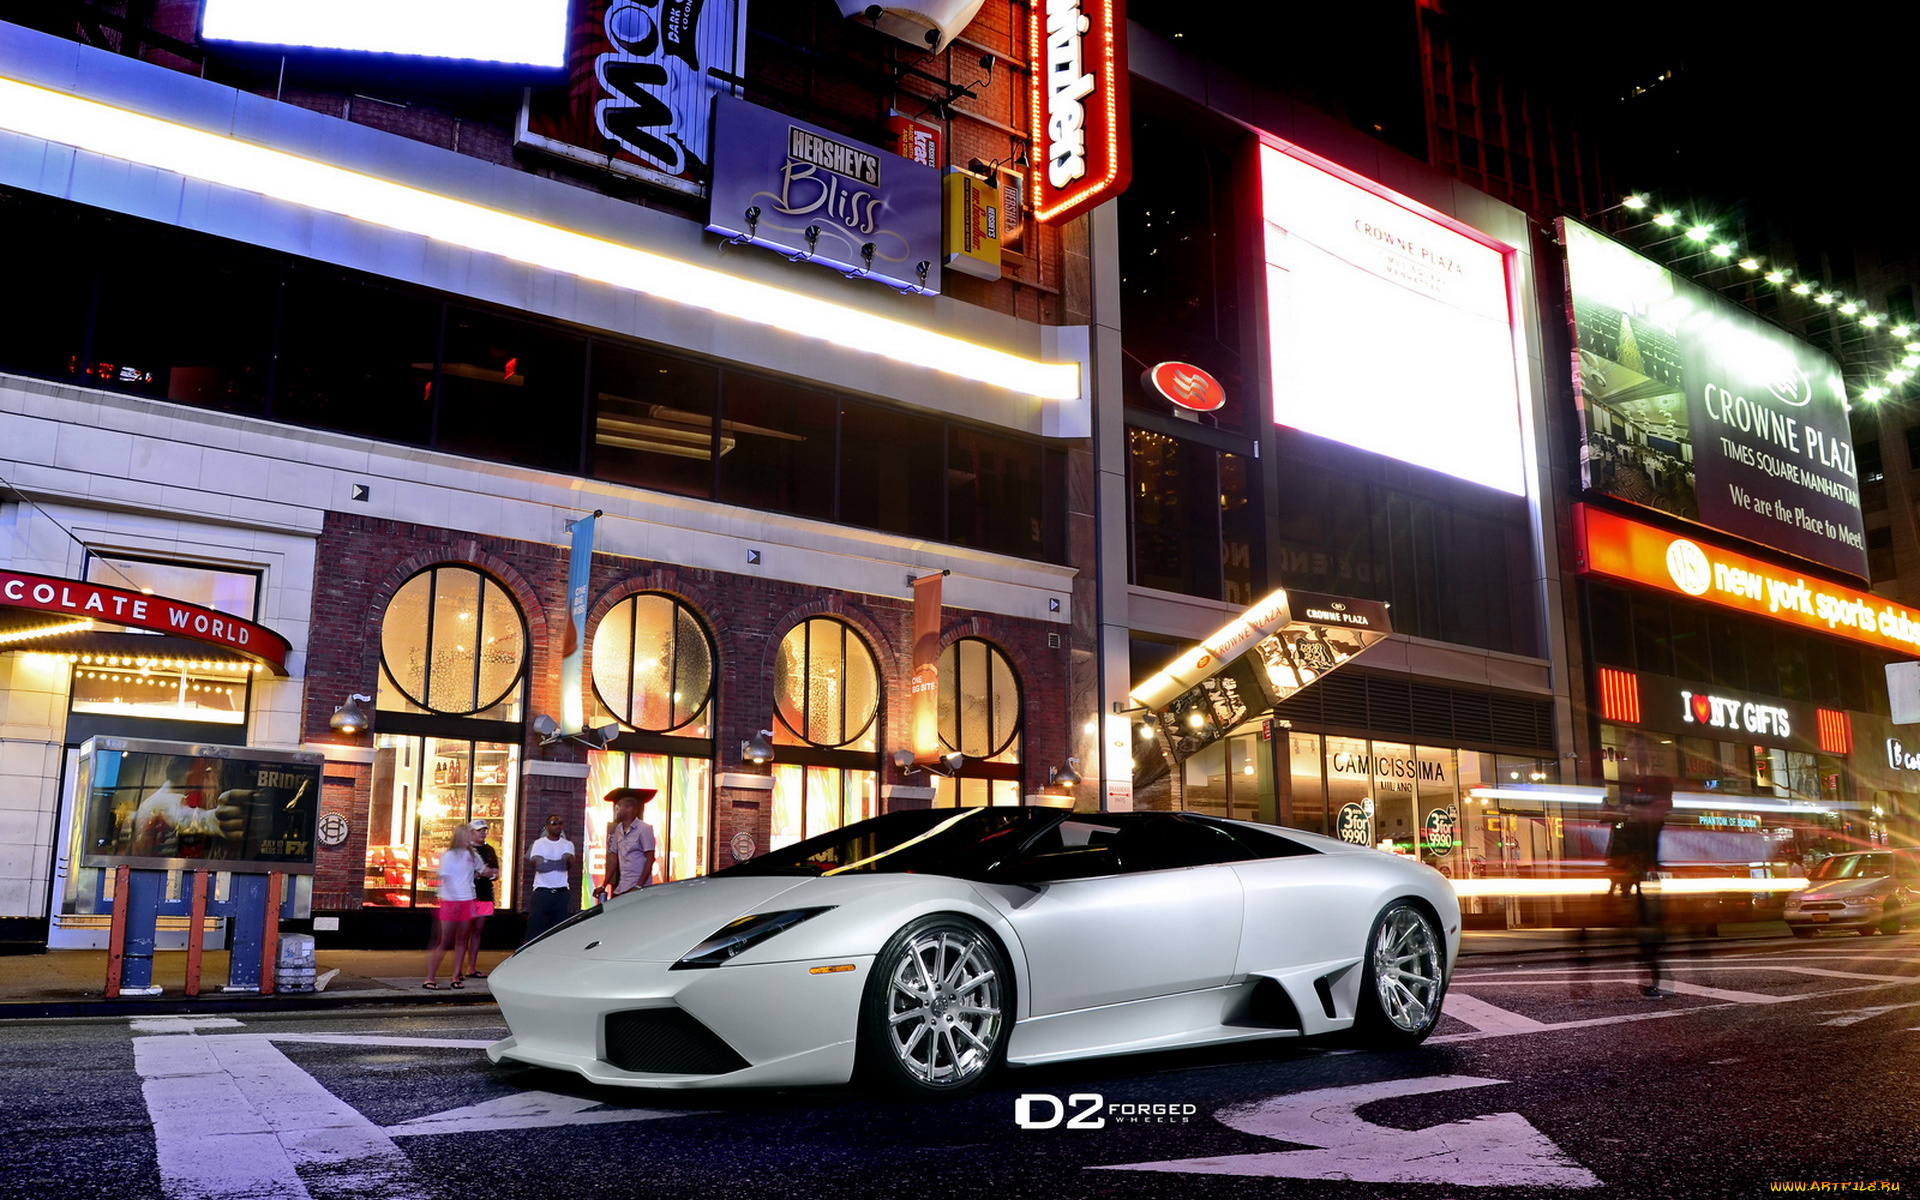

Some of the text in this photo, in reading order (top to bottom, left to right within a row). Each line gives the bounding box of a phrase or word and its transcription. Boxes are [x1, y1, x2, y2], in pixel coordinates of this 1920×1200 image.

[667, 8, 682, 44] DARK
[792, 130, 877, 184] HERSHEY'S
[771, 158, 885, 234] Bliss
[1355, 219, 1415, 255] CROWNE
[1421, 248, 1463, 275] PLAZA
[1704, 383, 1800, 454] CROWNE
[1720, 437, 1860, 510] TIMES SQUARE MANHATTAN
[1729, 484, 1751, 510] We
[1754, 497, 1772, 518] are
[1774, 499, 1793, 525] the
[1795, 507, 1824, 536] Place
[1825, 520, 1837, 540] to
[574, 595, 584, 606] BIG
[575, 584, 587, 596] ONE
[1714, 562, 1762, 601] new
[1765, 578, 1815, 616] york
[1815, 592, 1877, 632] sports
[1878, 606, 1920, 647] clubs
[4, 579, 250, 645] COLATE WORLD
[573, 604, 586, 616] KISS
[1306, 608, 1369, 625] CROWNE PLAZA
[1213, 607, 1283, 659] CROWNE PLAZA
[911, 675, 923, 686] ONE
[920, 681, 936, 692] BITE
[1681, 691, 1791, 738] I NY GIFTS
[257, 770, 313, 789] BRID
[1333, 752, 1446, 782] CAMICISSIMA
[1380, 780, 1413, 793] MILANO
[1344, 807, 1353, 829] 3
[1353, 815, 1368, 830] for
[1431, 813, 1440, 833] 3
[1440, 820, 1453, 834] for
[285, 841, 309, 855] FX
